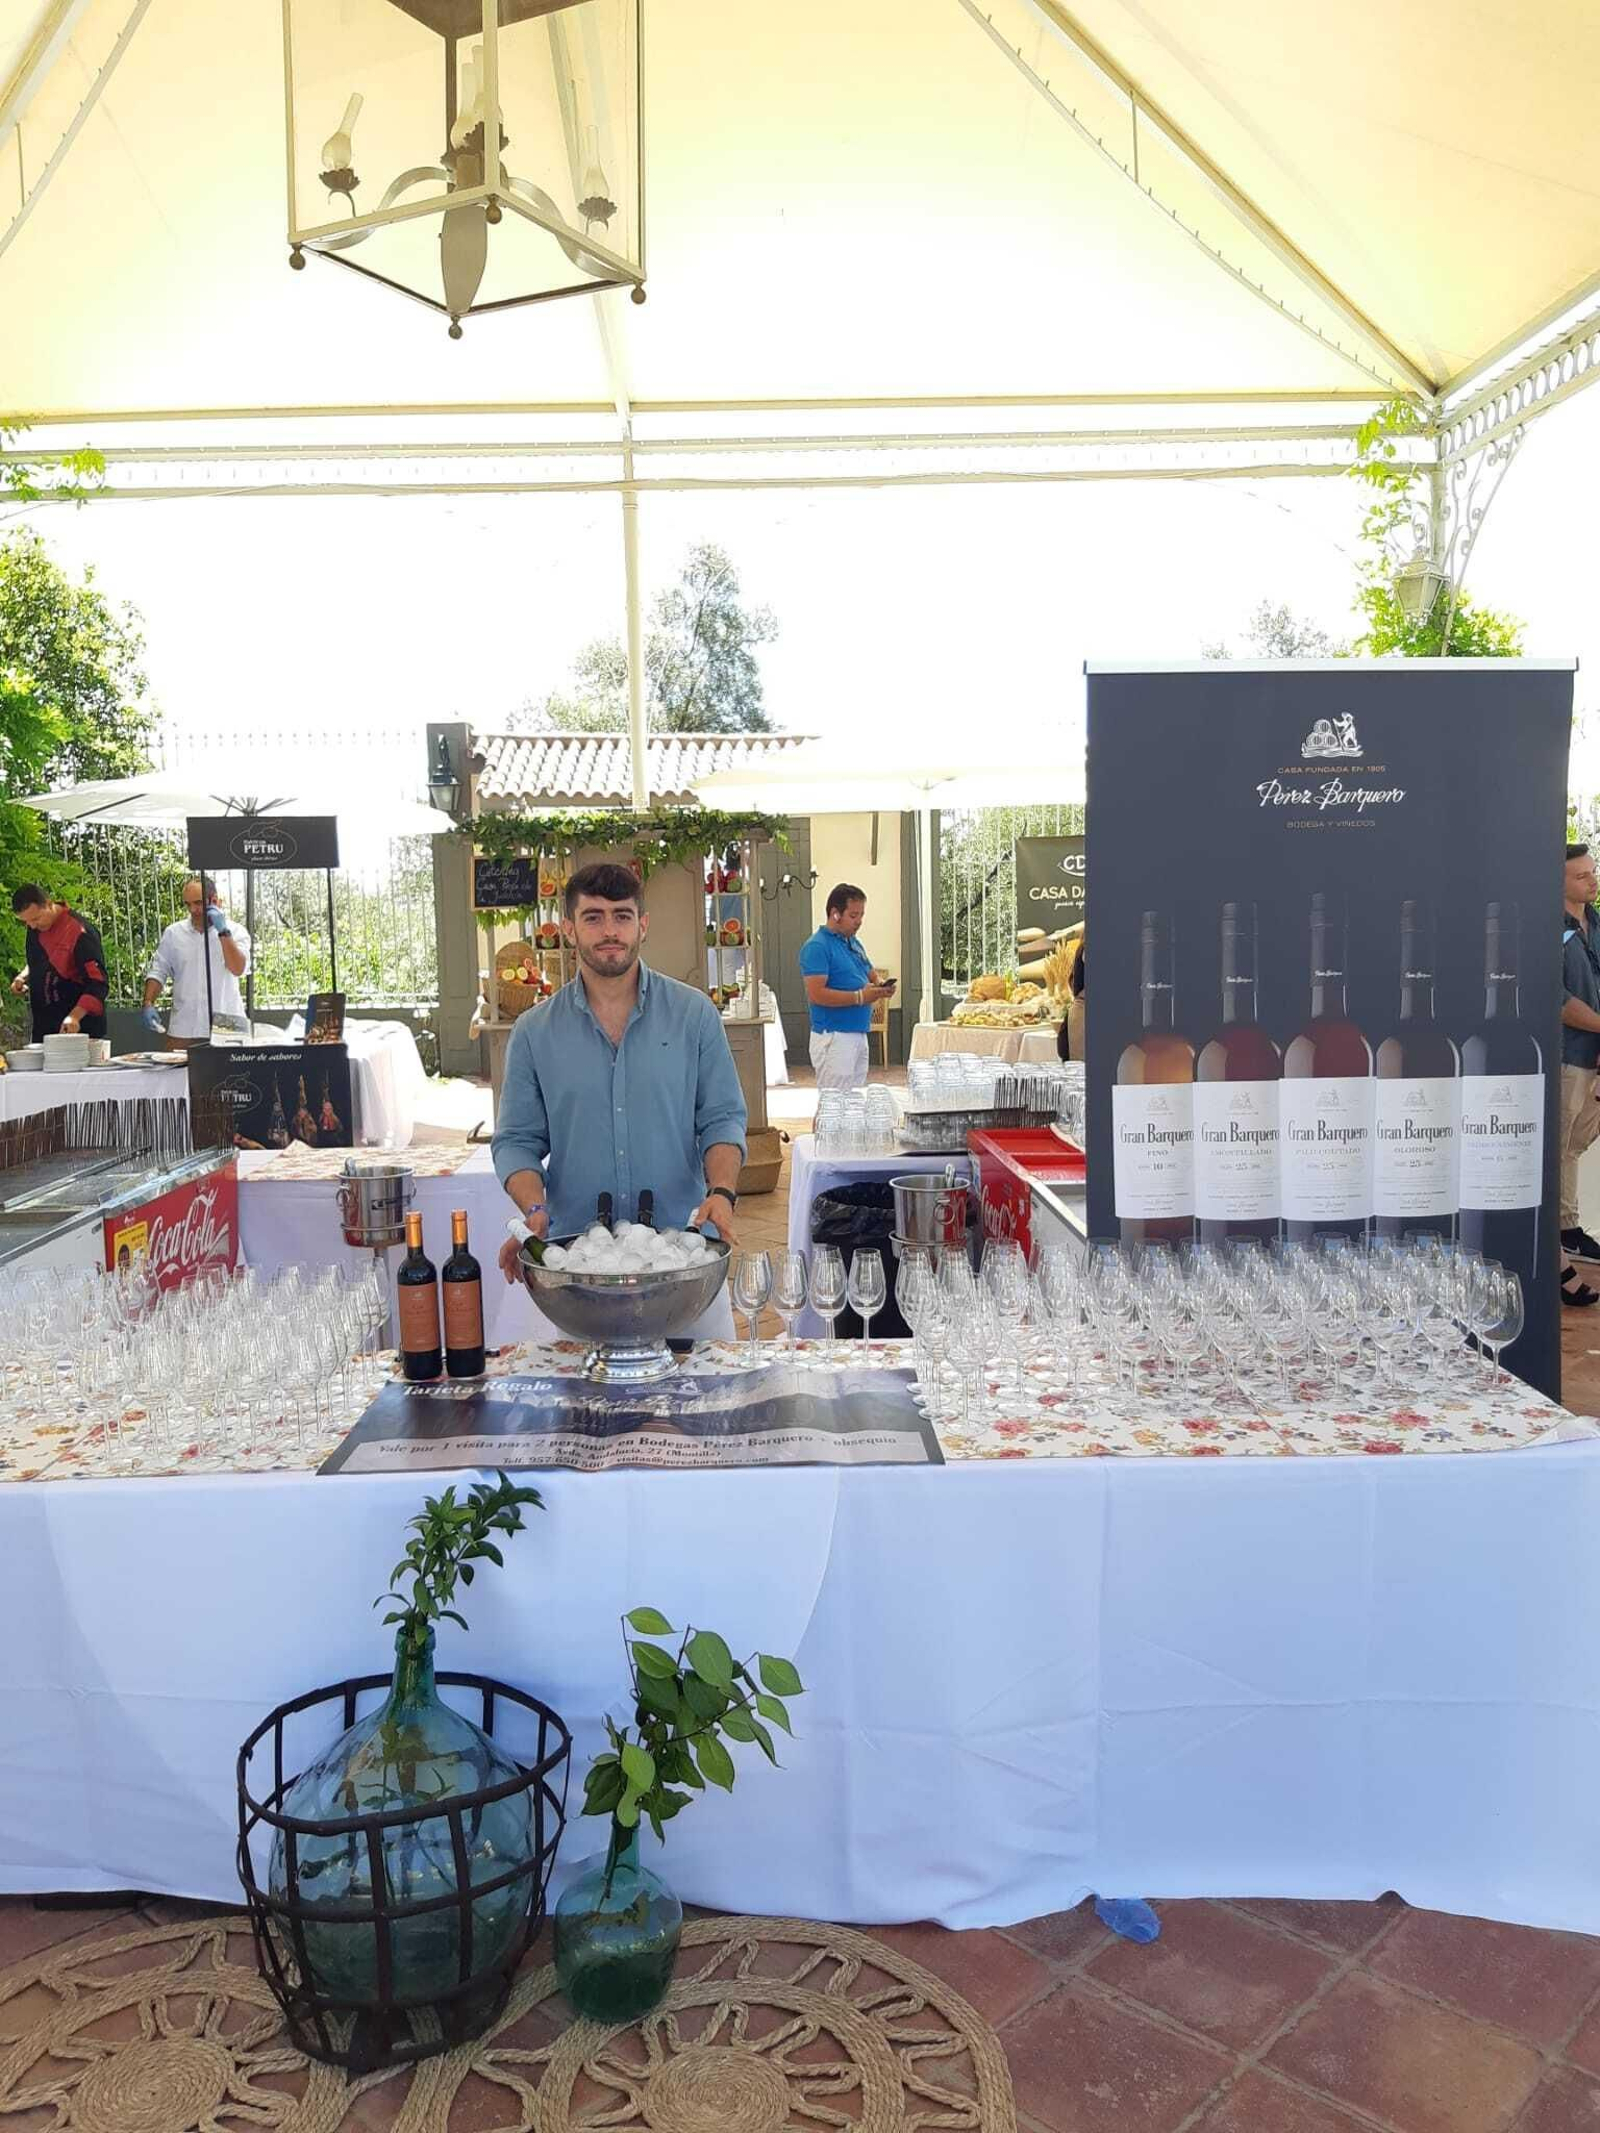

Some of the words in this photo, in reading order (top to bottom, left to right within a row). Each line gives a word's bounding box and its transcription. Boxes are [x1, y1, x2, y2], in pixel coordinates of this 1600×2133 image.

[1277, 766, 1303, 774] CASA
[1304, 766, 1349, 774] FUNDADA
[1313, 777, 1406, 812] Barquero
[244, 843, 284, 854] PETRU
[1029, 886, 1068, 901] CASA
[229, 1053, 256, 1062] Sabor
[257, 1053, 268, 1061] de
[268, 1052, 302, 1061] sabores
[1119, 1123, 1145, 1144] Gran
[1201, 1121, 1227, 1142] Gran
[1229, 1121, 1280, 1146] Barquero
[1288, 1119, 1315, 1142] Gran
[1317, 1119, 1368, 1145] Barquero
[1376, 1119, 1402, 1140] Gran
[1404, 1119, 1454, 1143] Barquero
[1462, 1115, 1487, 1135] Gran
[1489, 1114, 1538, 1138] Barquero
[404, 1384, 474, 1397] Tarjeta
[480, 1380, 553, 1393] Regalo
[410, 1446, 435, 1454] por
[443, 1441, 451, 1450] 1
[455, 1440, 493, 1450] visita
[497, 1441, 532, 1450] para
[549, 1439, 613, 1452] personas
[617, 1438, 635, 1448] en
[639, 1436, 699, 1450] Bodegas
[747, 1434, 814, 1448] Barquero
[832, 1436, 898, 1447] obsequio
